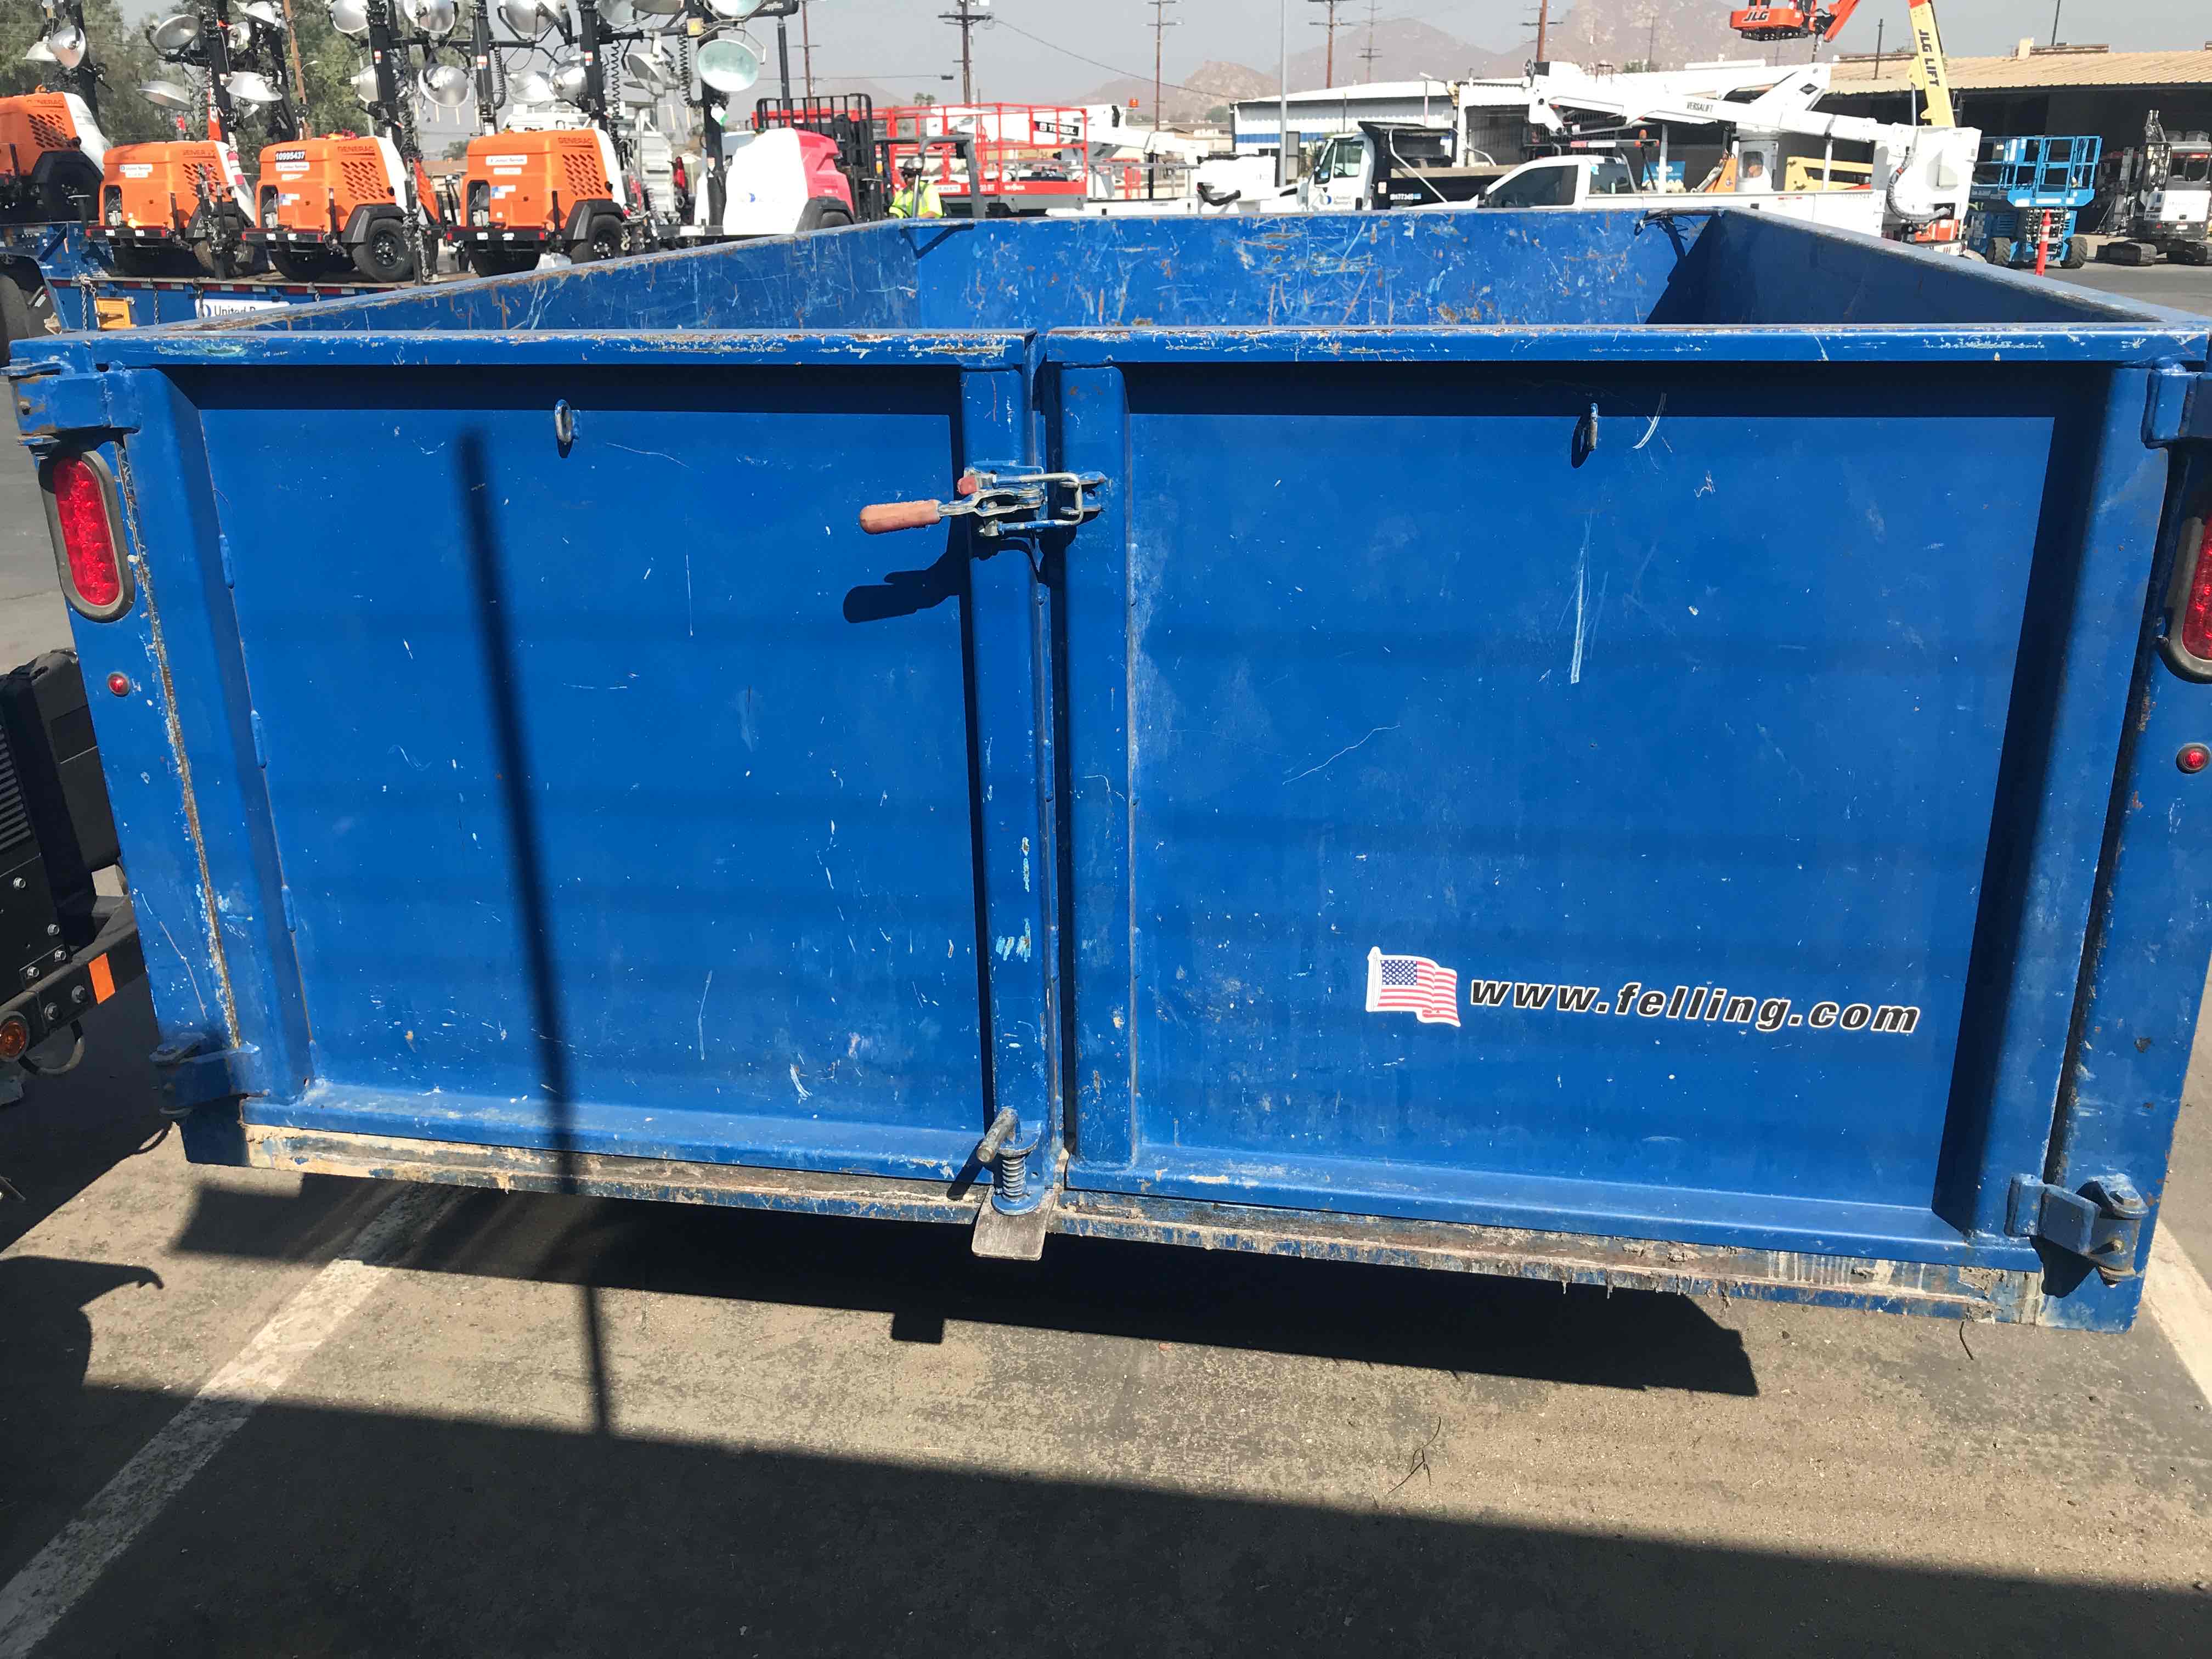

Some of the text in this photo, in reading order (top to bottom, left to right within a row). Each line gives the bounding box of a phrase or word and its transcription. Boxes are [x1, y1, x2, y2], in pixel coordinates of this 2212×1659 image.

[1742, 10, 1770, 22] JLG
[1918, 29, 1940, 87] JLG LIFT
[275, 151, 306, 161] 10995437
[1470, 979, 1921, 1034] www.felling.com
